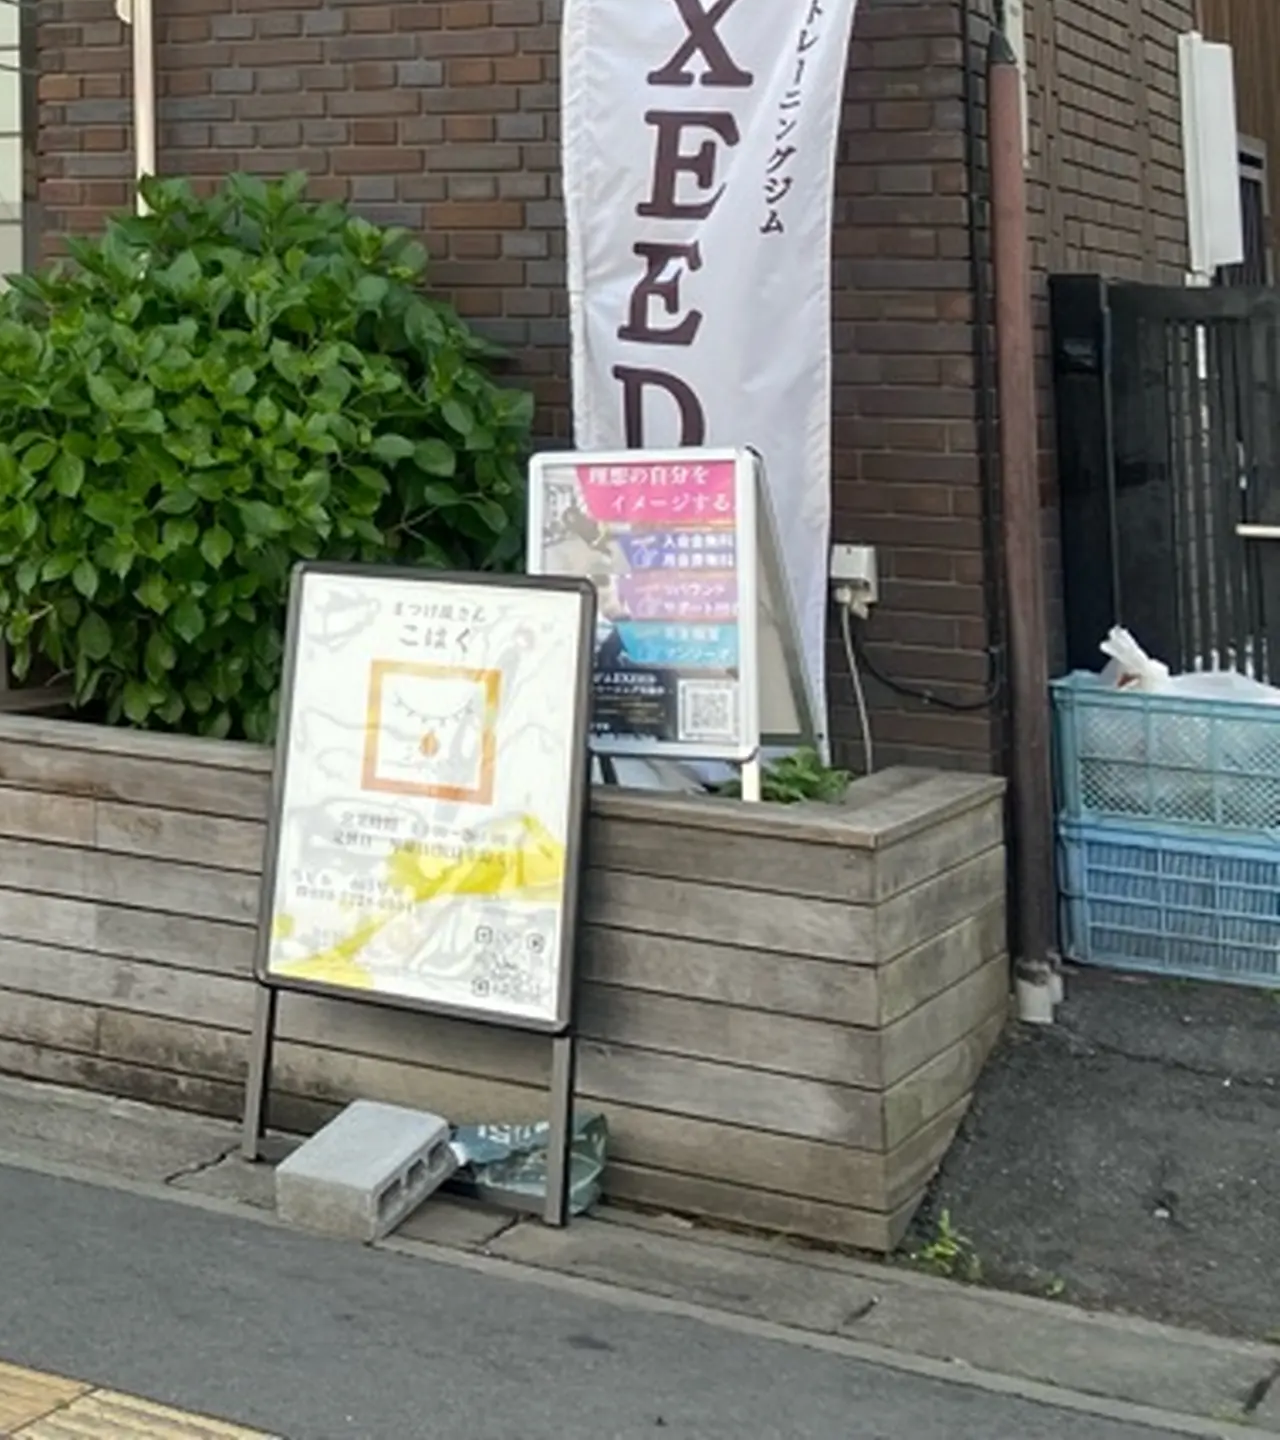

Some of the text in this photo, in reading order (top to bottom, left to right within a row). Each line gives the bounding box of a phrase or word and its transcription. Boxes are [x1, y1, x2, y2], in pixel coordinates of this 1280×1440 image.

[589, 464, 709, 486] 理想の自分を
[399, 623, 472, 654] こはく
